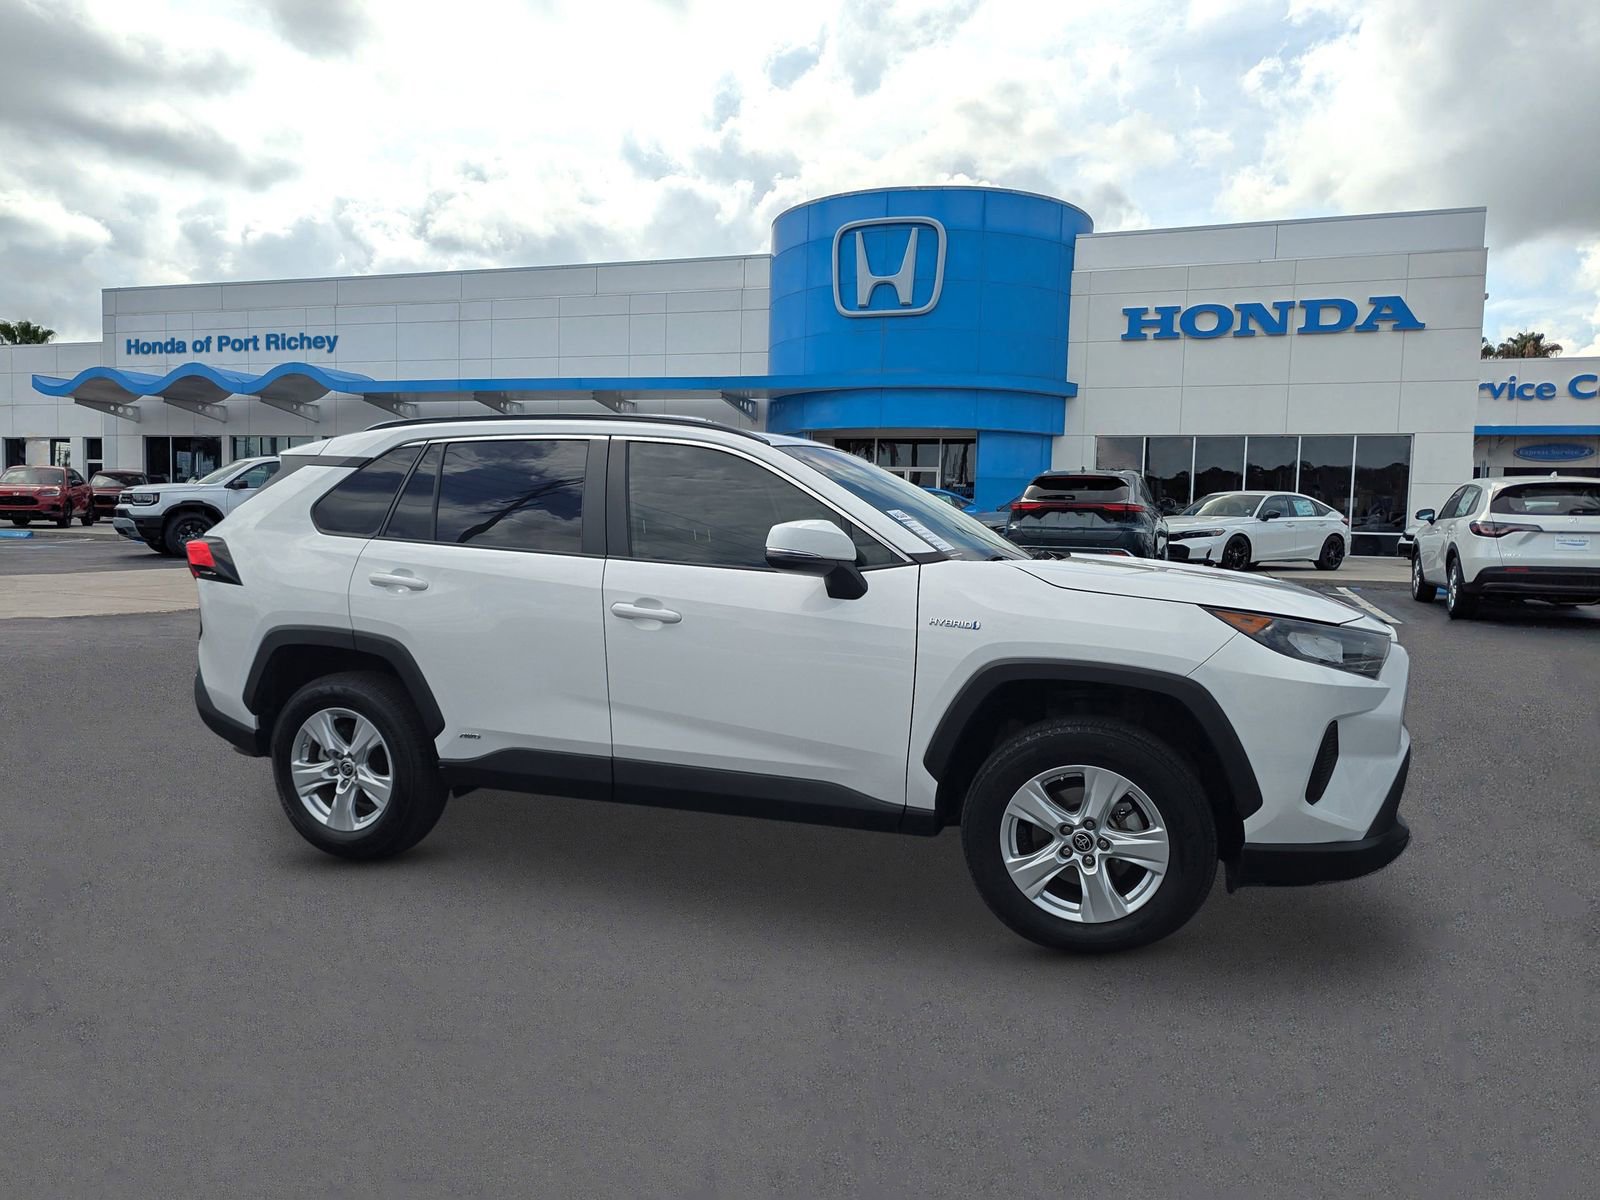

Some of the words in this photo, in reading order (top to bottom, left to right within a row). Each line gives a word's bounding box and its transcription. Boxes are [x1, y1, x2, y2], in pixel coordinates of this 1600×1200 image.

[1121, 295, 1425, 341] HONDA
[126, 337, 187, 355] Honda
[191, 335, 212, 353] of
[217, 335, 260, 353] Port
[265, 332, 339, 353] Richey
[1478, 375, 1557, 401] vice
[1568, 374, 1600, 400] C
[929, 617, 973, 630] HYBRID
